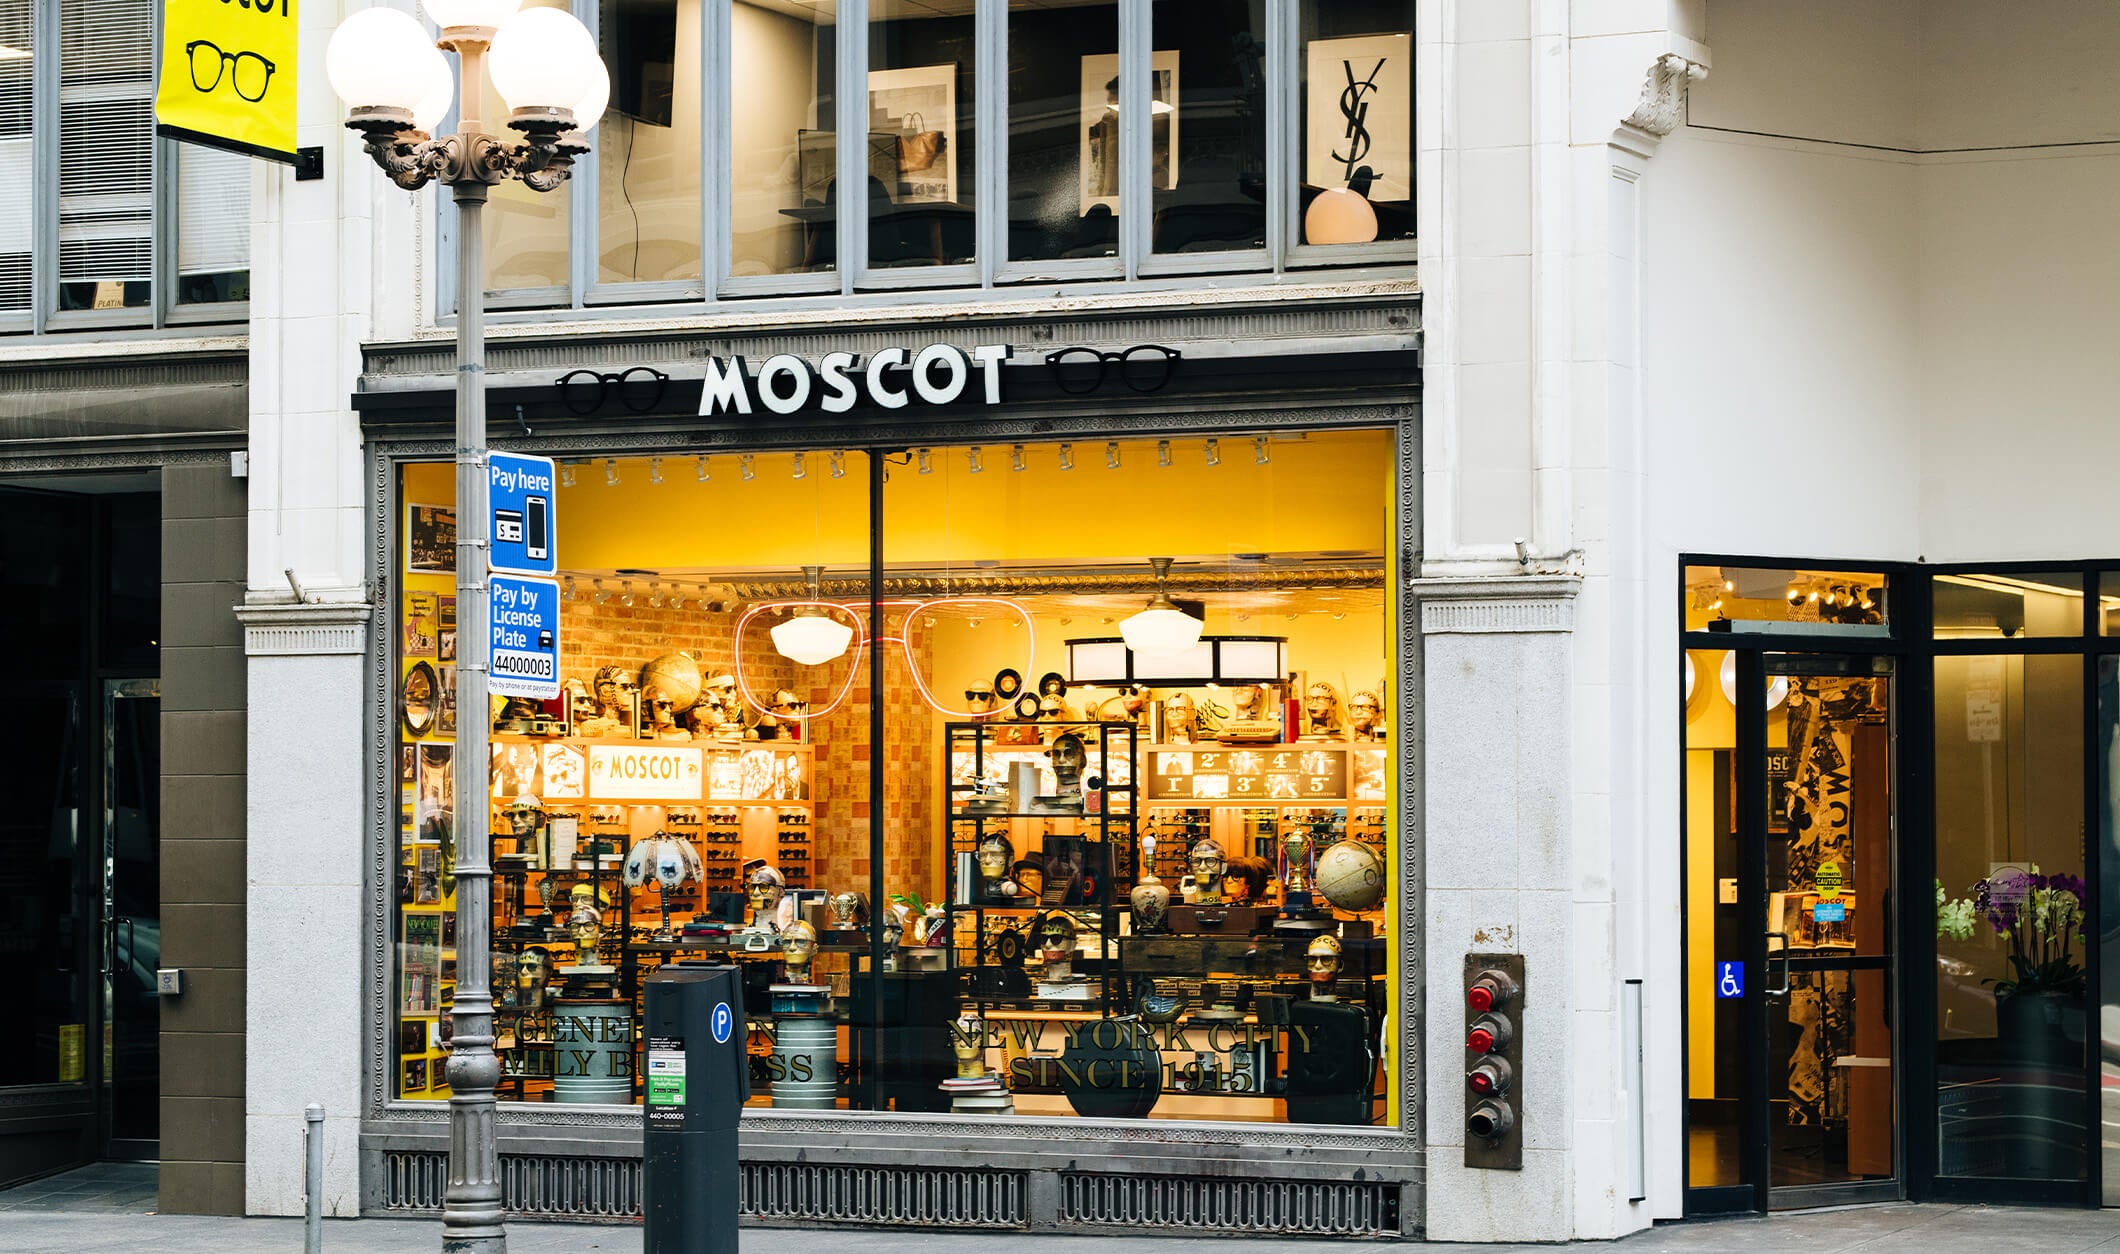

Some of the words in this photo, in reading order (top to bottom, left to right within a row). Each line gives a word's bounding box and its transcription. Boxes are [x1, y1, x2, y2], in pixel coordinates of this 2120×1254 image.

[698, 343, 1010, 416] MOSCOT
[491, 465, 517, 493] Pay
[518, 467, 550, 492] here
[493, 583, 518, 608] Pay
[521, 585, 538, 611] by
[493, 605, 542, 628] License
[493, 626, 527, 648] Plate
[494, 655, 552, 676] 44000003
[609, 754, 681, 780] MOSCOT
[1816, 877, 1842, 885] CAUTION
[945, 1018, 1049, 1049] NEW
[1058, 1019, 1196, 1052] YORK
[1208, 1022, 1321, 1055] CITY
[1009, 1056, 1146, 1089] SINCE
[1161, 1059, 1253, 1093] 1915
[649, 1112, 685, 1120] 440-00005
